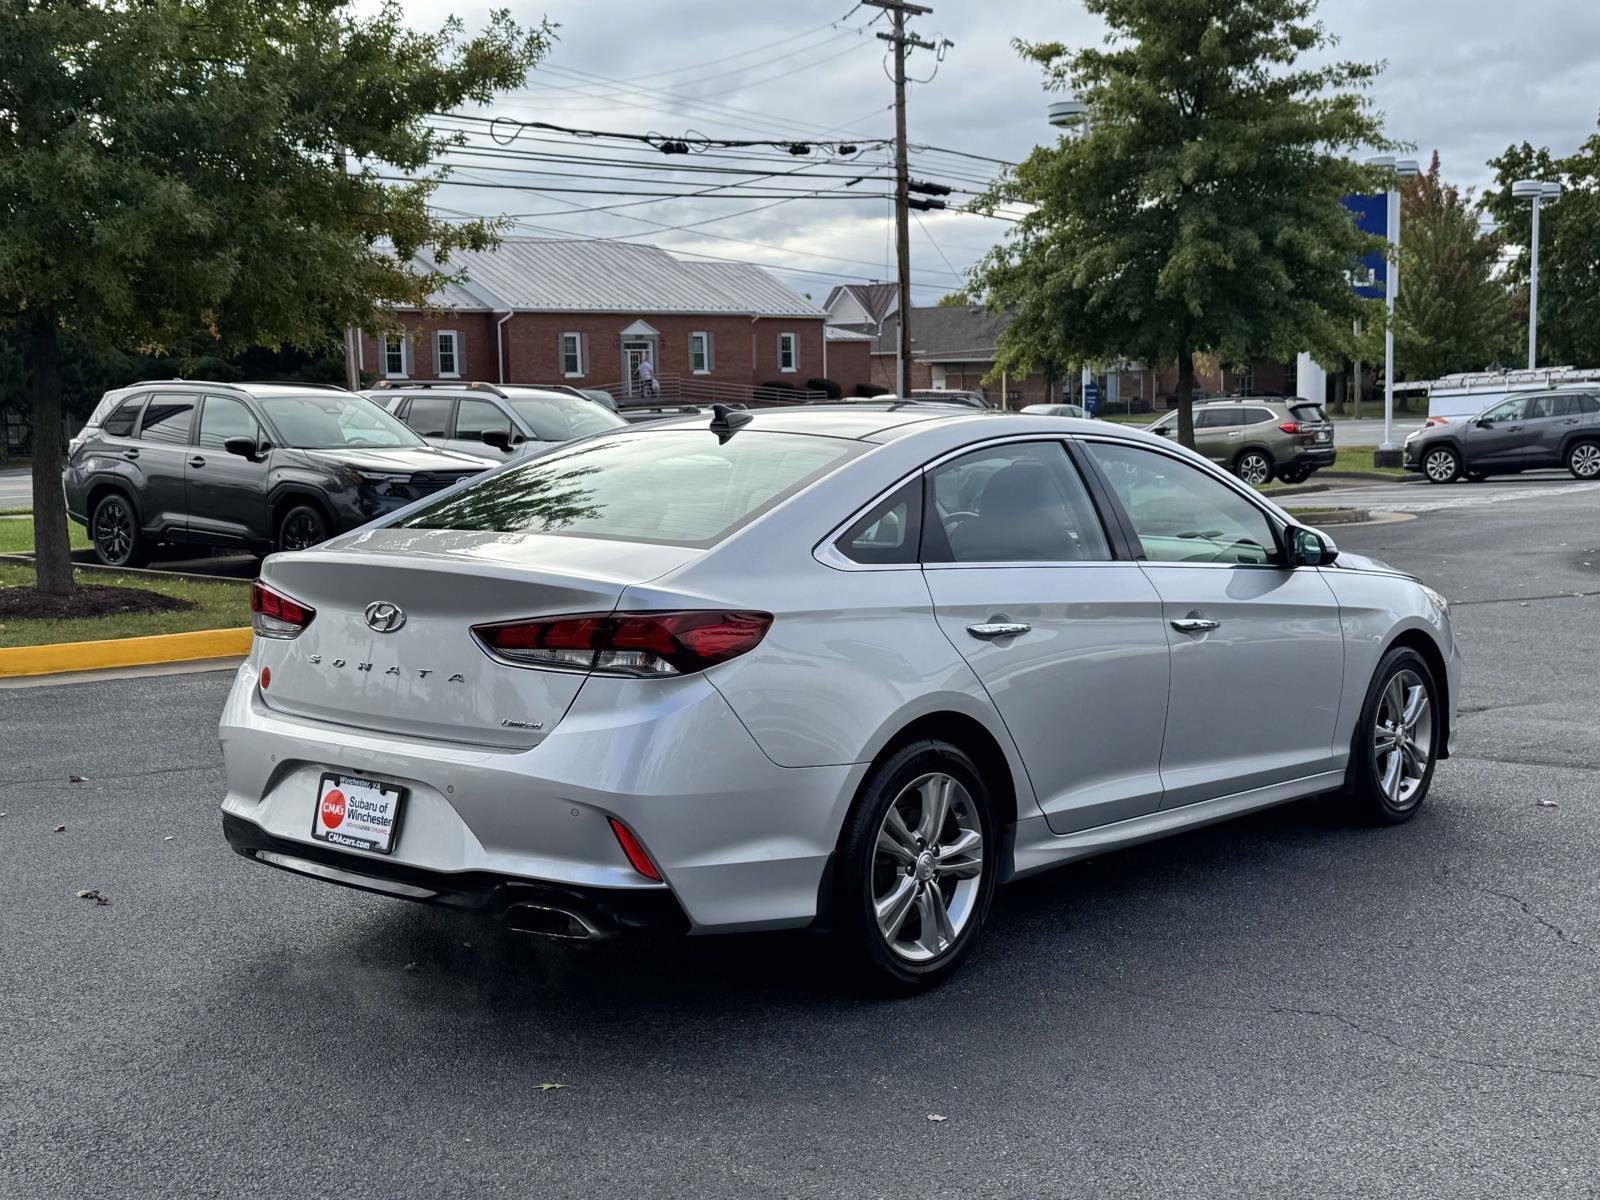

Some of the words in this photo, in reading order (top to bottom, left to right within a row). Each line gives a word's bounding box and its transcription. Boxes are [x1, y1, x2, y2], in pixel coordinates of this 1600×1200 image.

[308, 654, 465, 684] SONATA
[500, 718, 544, 730] Limited
[323, 803, 344, 815] CMA's
[349, 796, 378, 812] Subaru
[379, 802, 389, 813] of
[348, 808, 392, 826] Winchester
[328, 833, 370, 849] CMAcars.com
